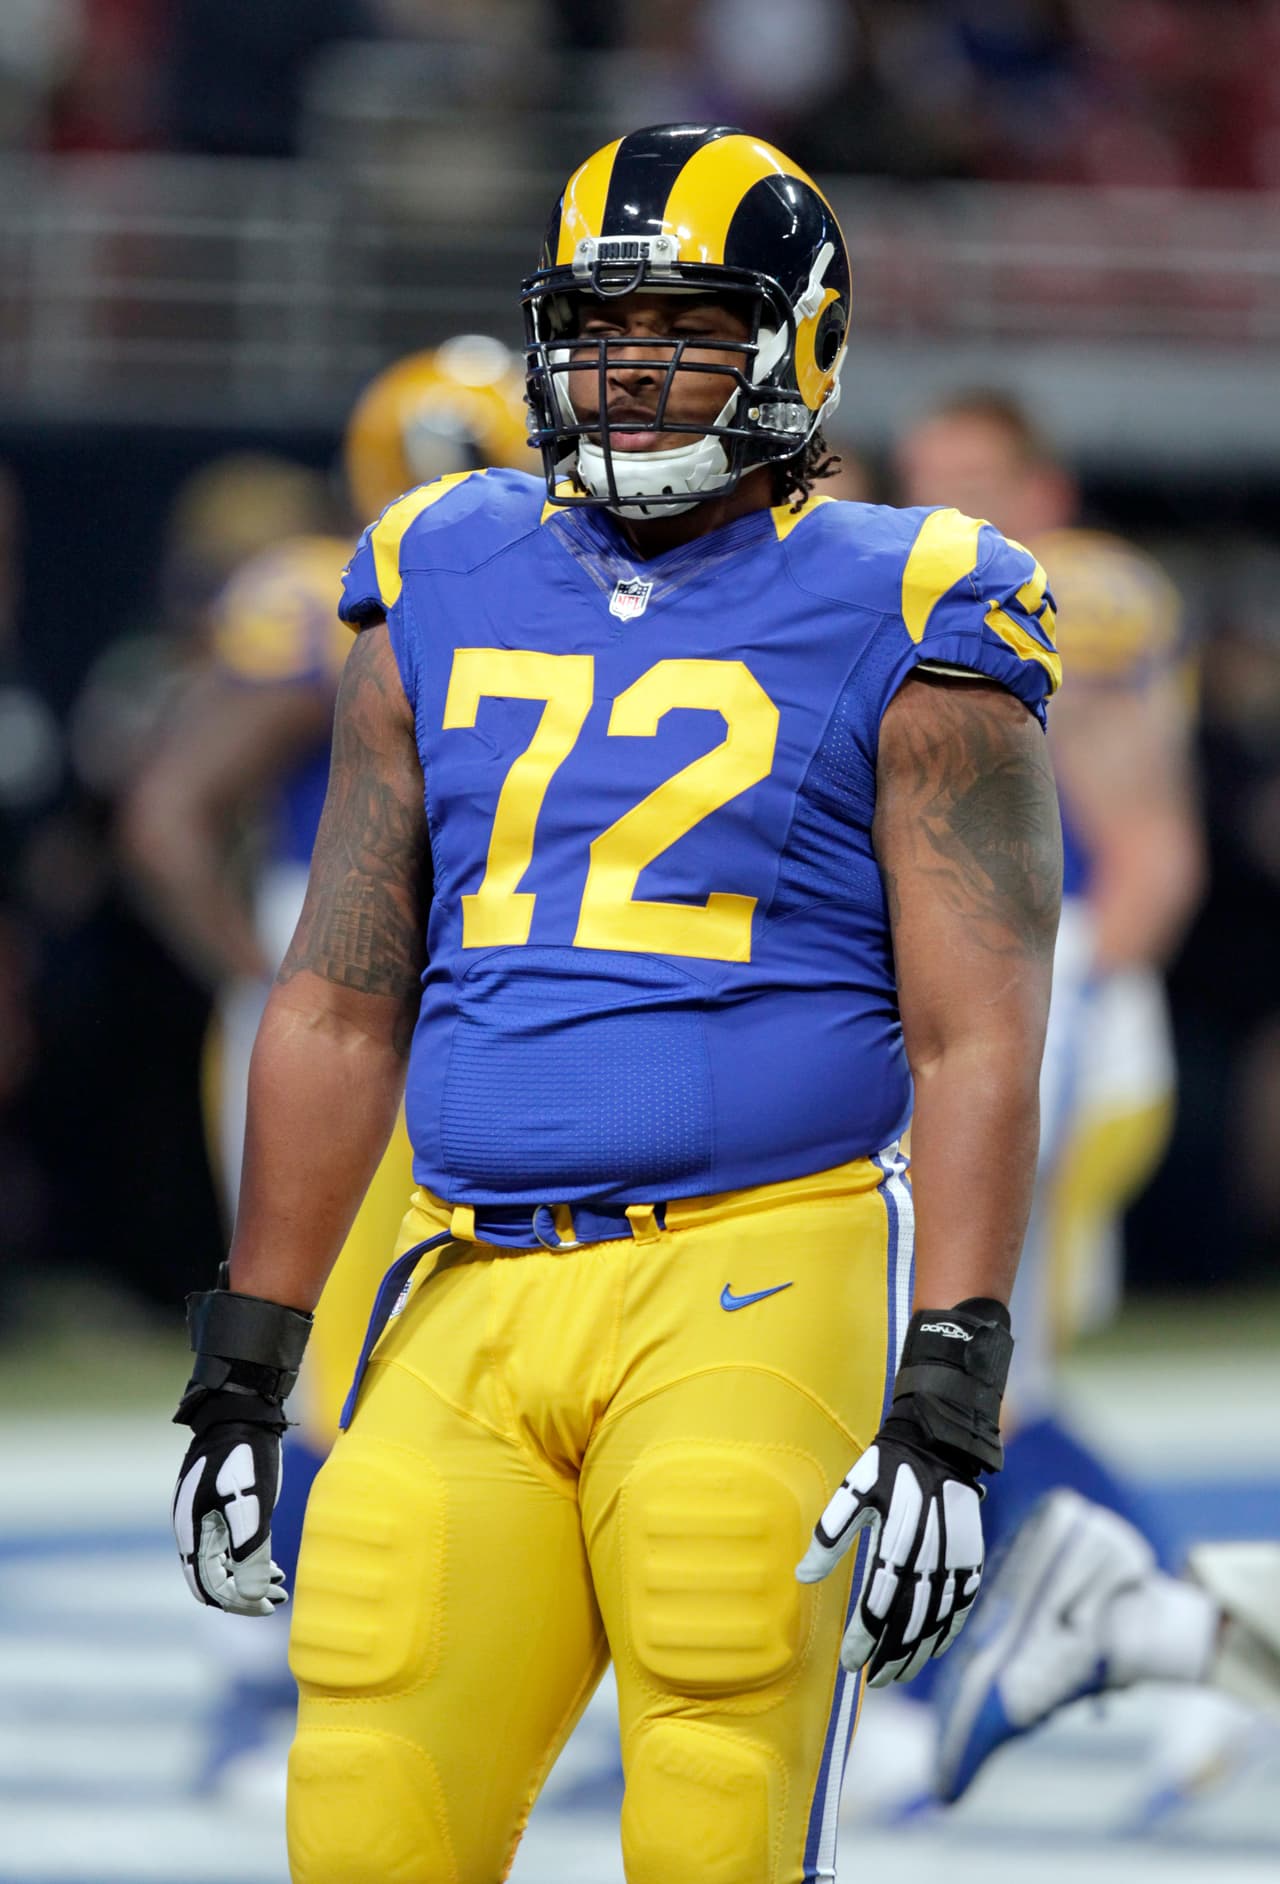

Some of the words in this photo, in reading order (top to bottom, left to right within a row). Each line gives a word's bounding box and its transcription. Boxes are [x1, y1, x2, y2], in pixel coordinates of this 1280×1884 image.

[598, 242, 650, 259] RAMS
[616, 595, 641, 611] NFL
[443, 648, 780, 963] 72
[920, 1322, 974, 1342] DONJOY
